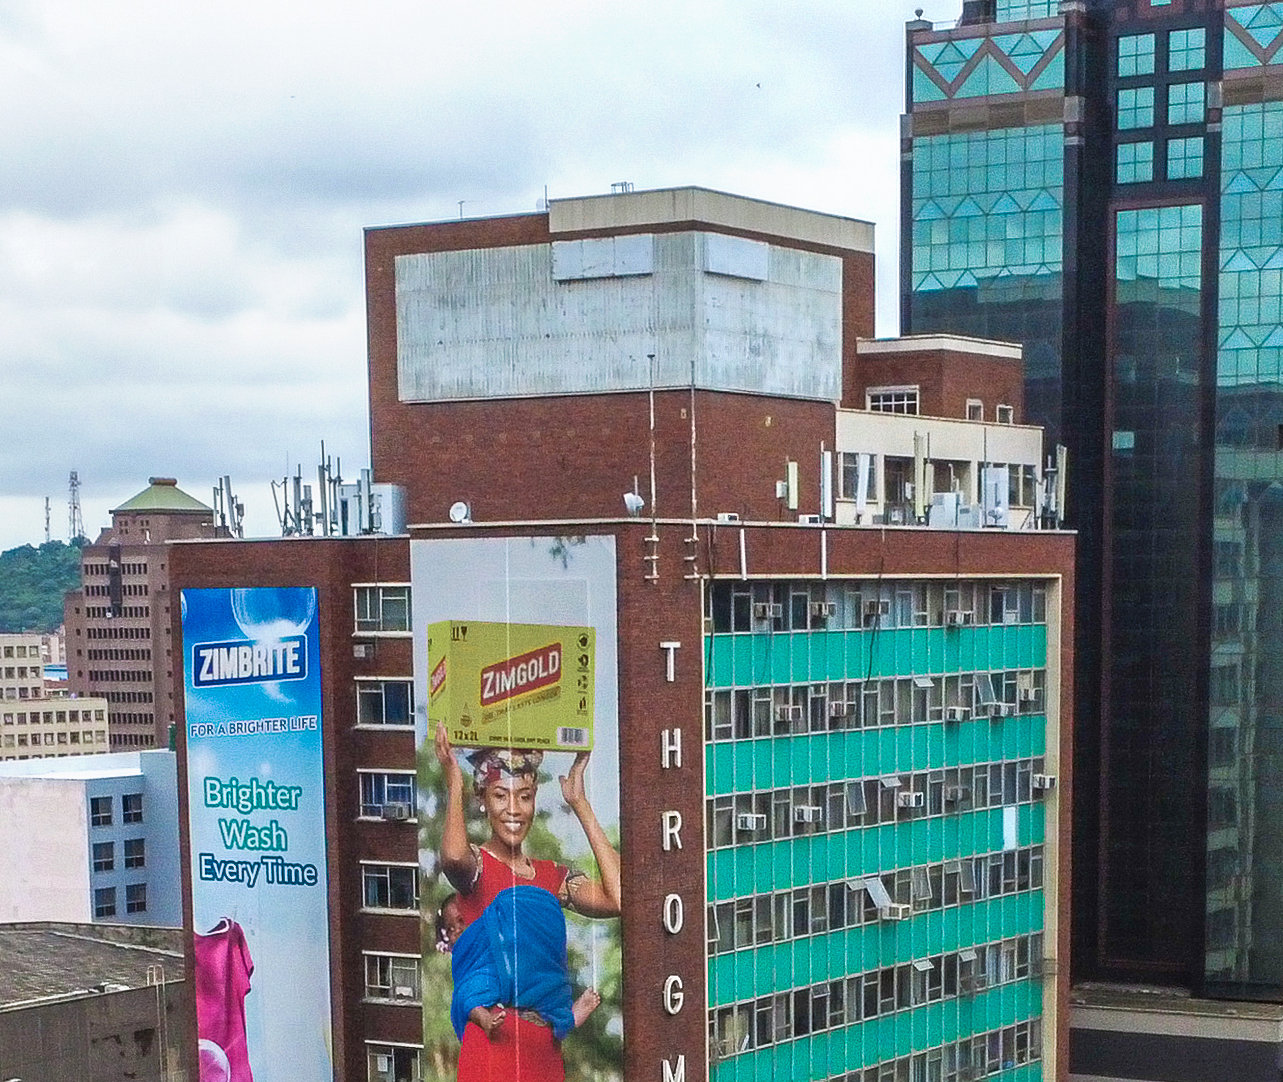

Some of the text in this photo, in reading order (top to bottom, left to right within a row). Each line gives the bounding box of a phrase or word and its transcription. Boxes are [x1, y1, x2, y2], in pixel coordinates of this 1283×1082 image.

[199, 641, 301, 681] ZIMBRITE
[483, 651, 560, 699] ZIMGOLD
[191, 716, 317, 738] FOR A BRIGHTER LIFE
[205, 778, 301, 814] Brighter
[219, 819, 287, 851] Wash
[200, 854, 317, 888] Every Time
